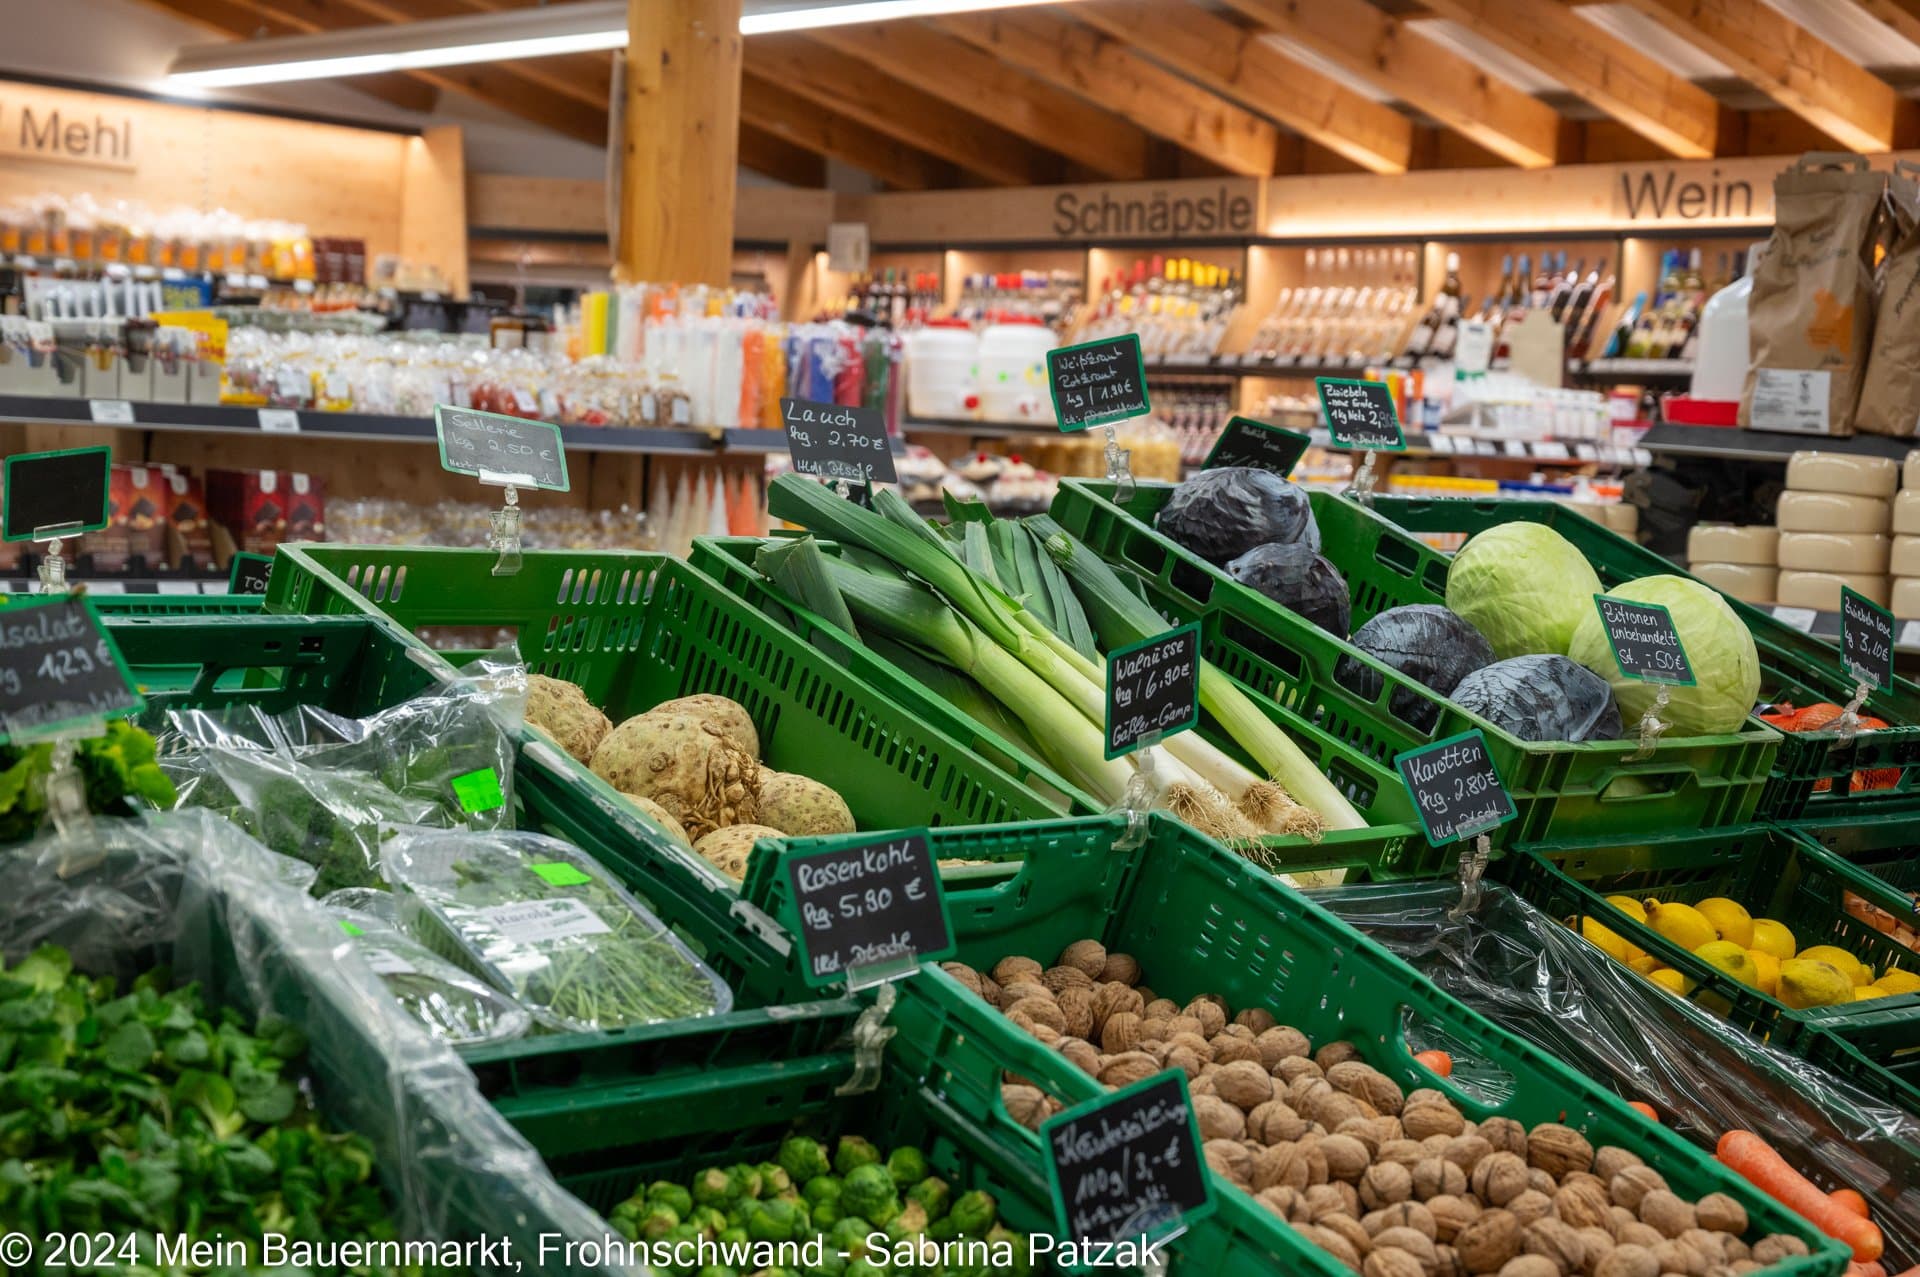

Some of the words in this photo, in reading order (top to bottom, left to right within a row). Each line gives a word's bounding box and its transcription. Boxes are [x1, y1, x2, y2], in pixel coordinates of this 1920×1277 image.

[20, 105, 131, 160] Mehl
[1053, 185, 1252, 240] Schnäpsle
[1621, 168, 1753, 220] Wein
[1324, 384, 1368, 398] Zwiebeln
[452, 414, 526, 439] Sellerie
[787, 401, 857, 429] Lauch
[1603, 602, 1658, 627] Zitronen
[1611, 626, 1678, 646] unbehandelt
[1116, 640, 1185, 682] Walnüsse
[1408, 745, 1482, 786] Karotten
[798, 840, 915, 894] Rosenkohl
